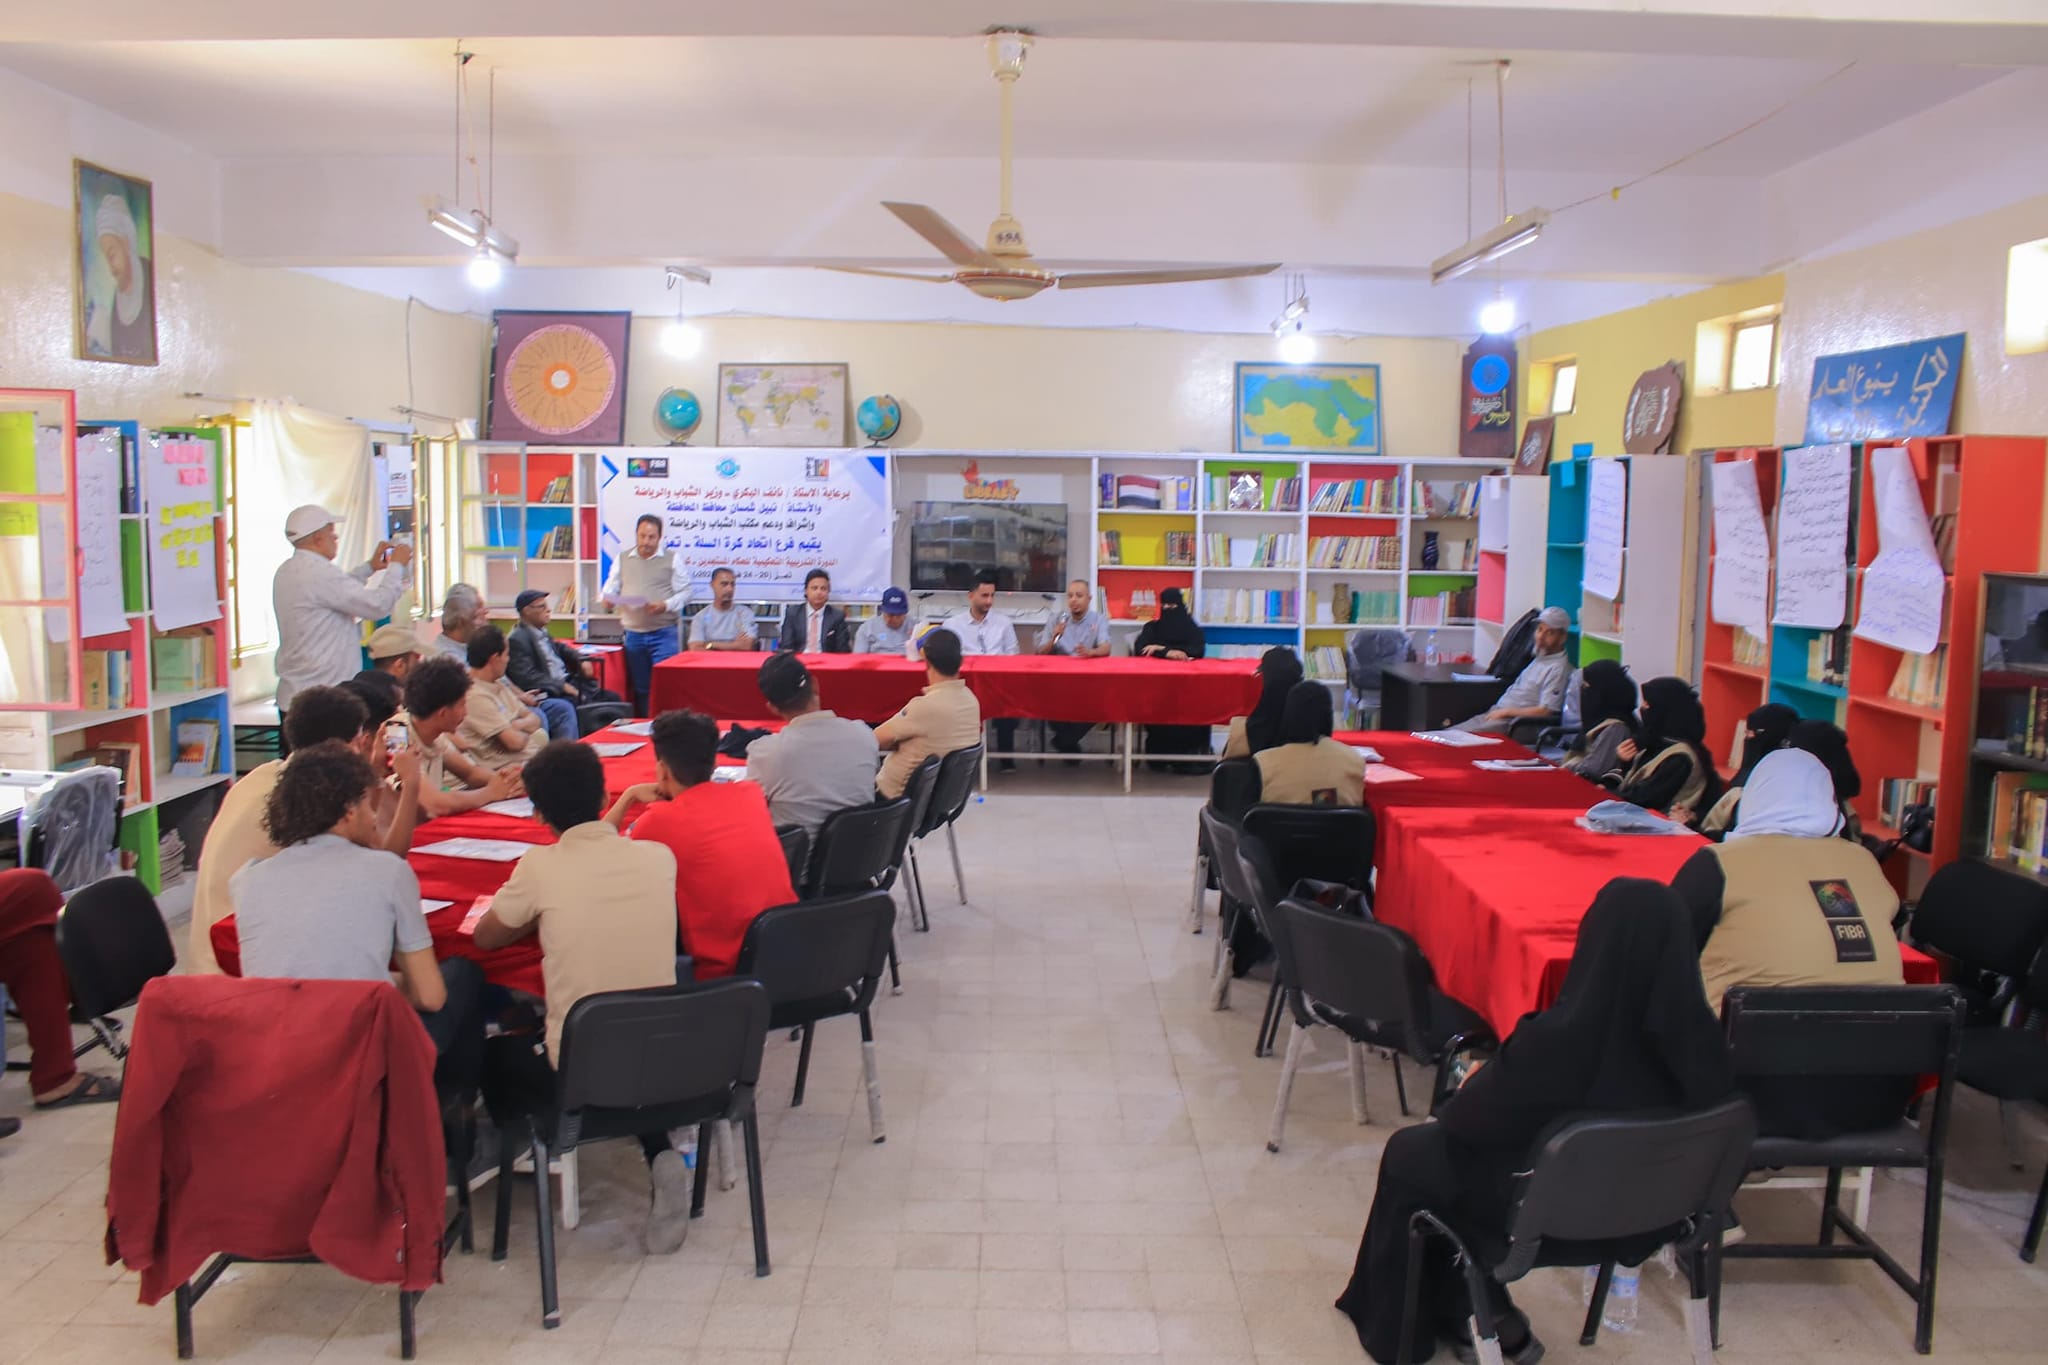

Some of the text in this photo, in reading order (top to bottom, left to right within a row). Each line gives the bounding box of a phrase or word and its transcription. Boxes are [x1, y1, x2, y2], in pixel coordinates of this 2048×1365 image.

[694, 536, 721, 548] السلة
[724, 536, 742, 551] كرة
[775, 536, 794, 552] فرع
[798, 536, 823, 552] يقيم
[1836, 925, 1866, 939] FIBA
